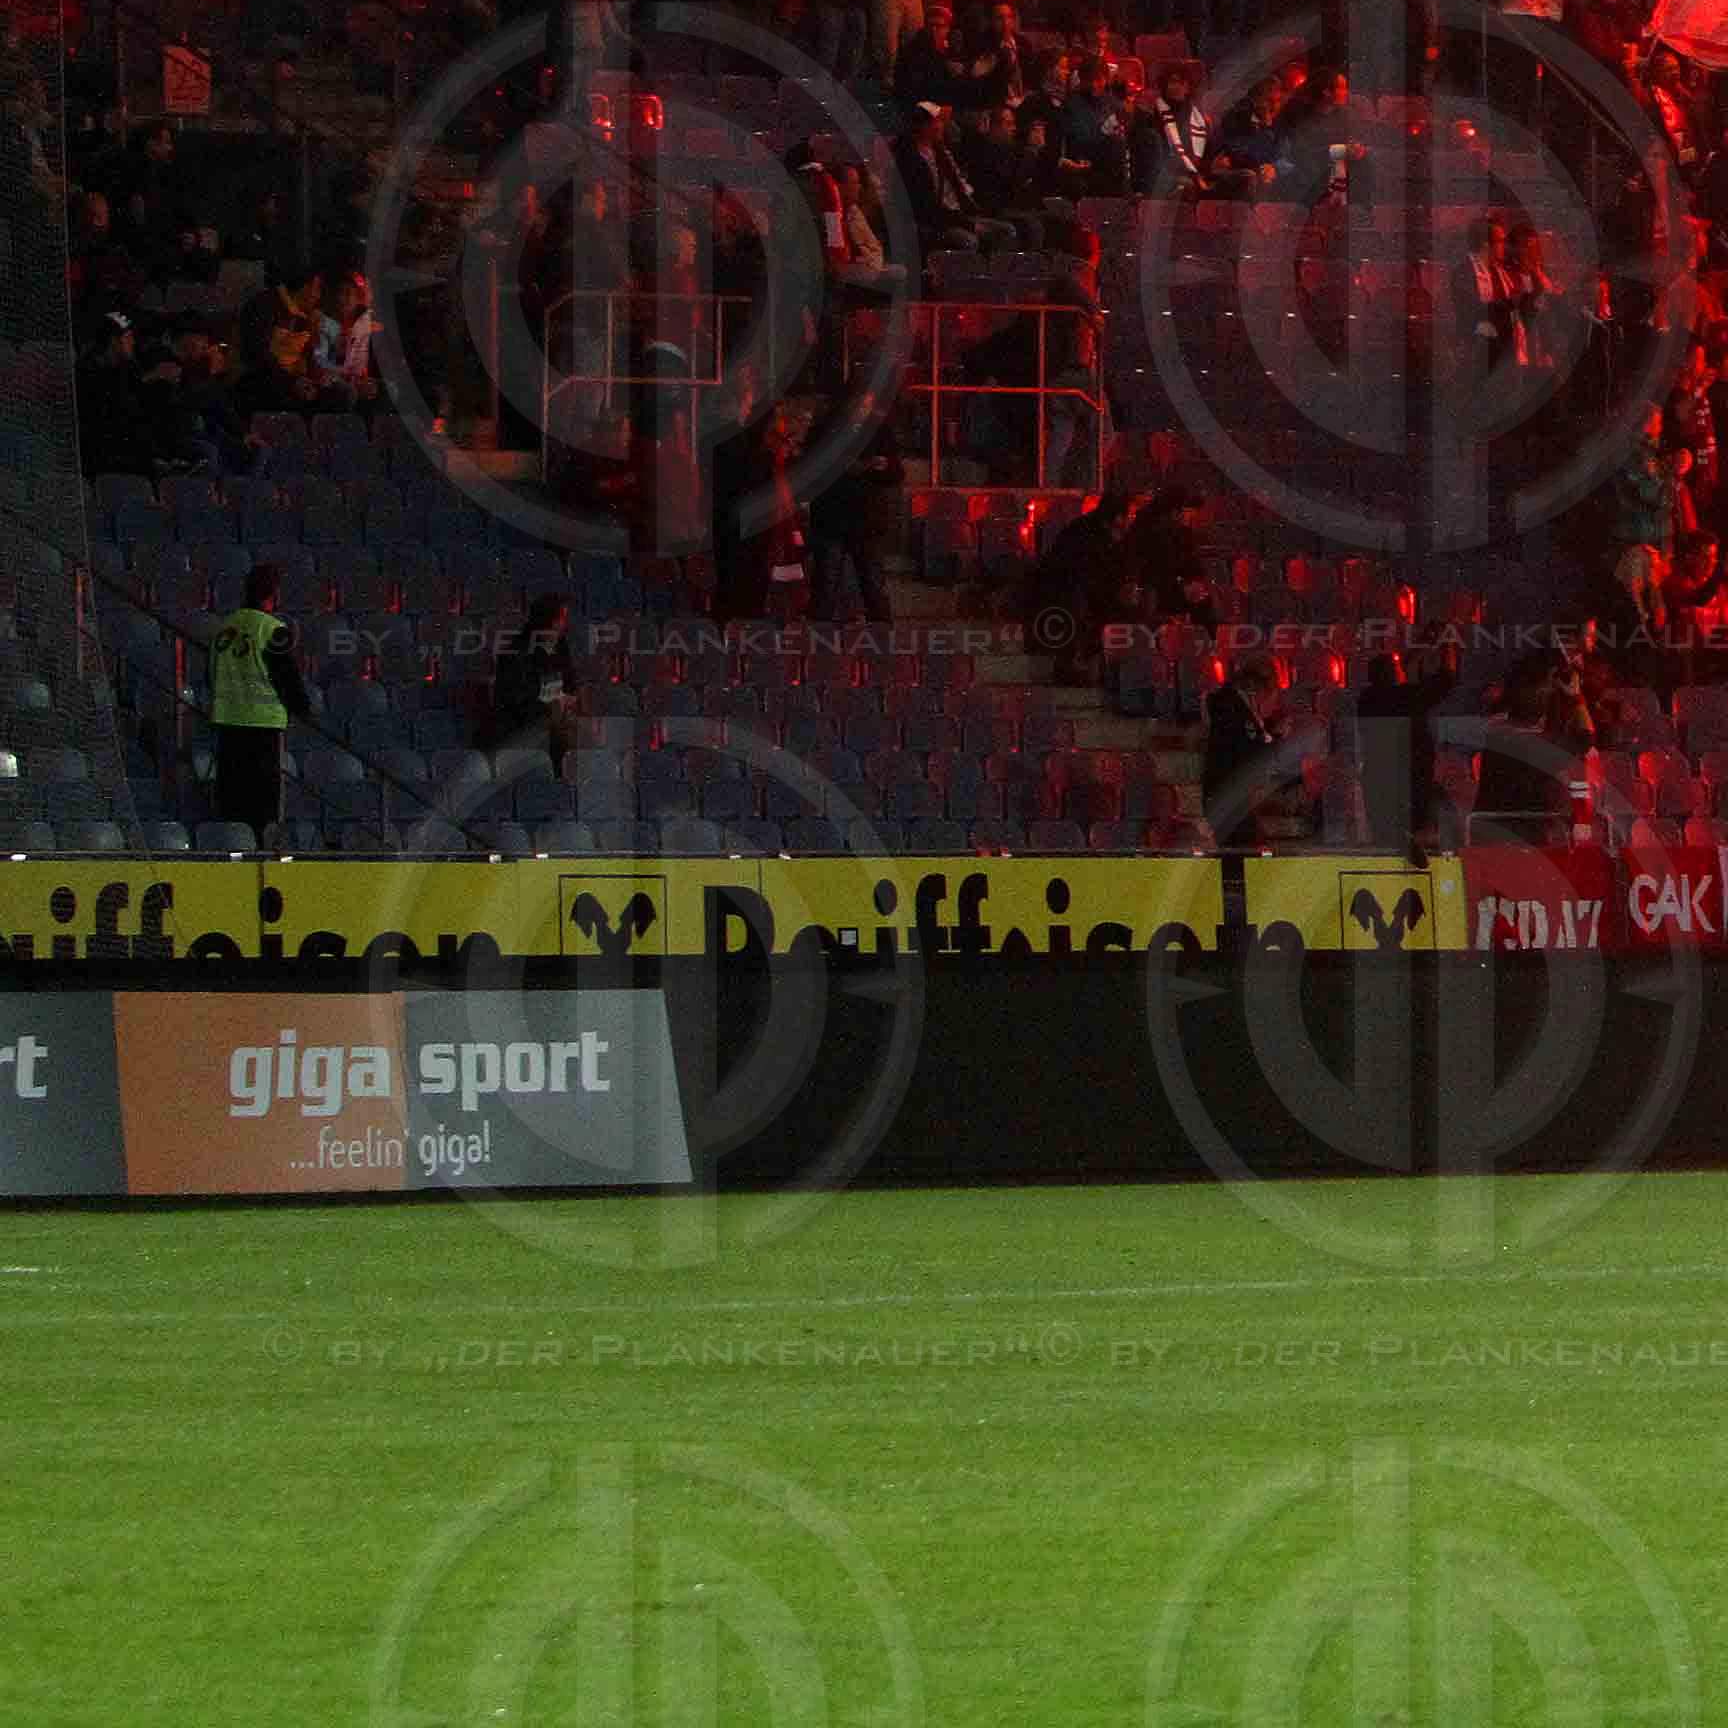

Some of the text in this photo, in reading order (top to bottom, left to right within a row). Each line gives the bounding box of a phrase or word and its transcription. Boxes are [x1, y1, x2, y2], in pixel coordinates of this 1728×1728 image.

[1628, 873, 1716, 935] GAK
[229, 1029, 611, 1119] giga sport
[417, 1119, 492, 1177] giga!
